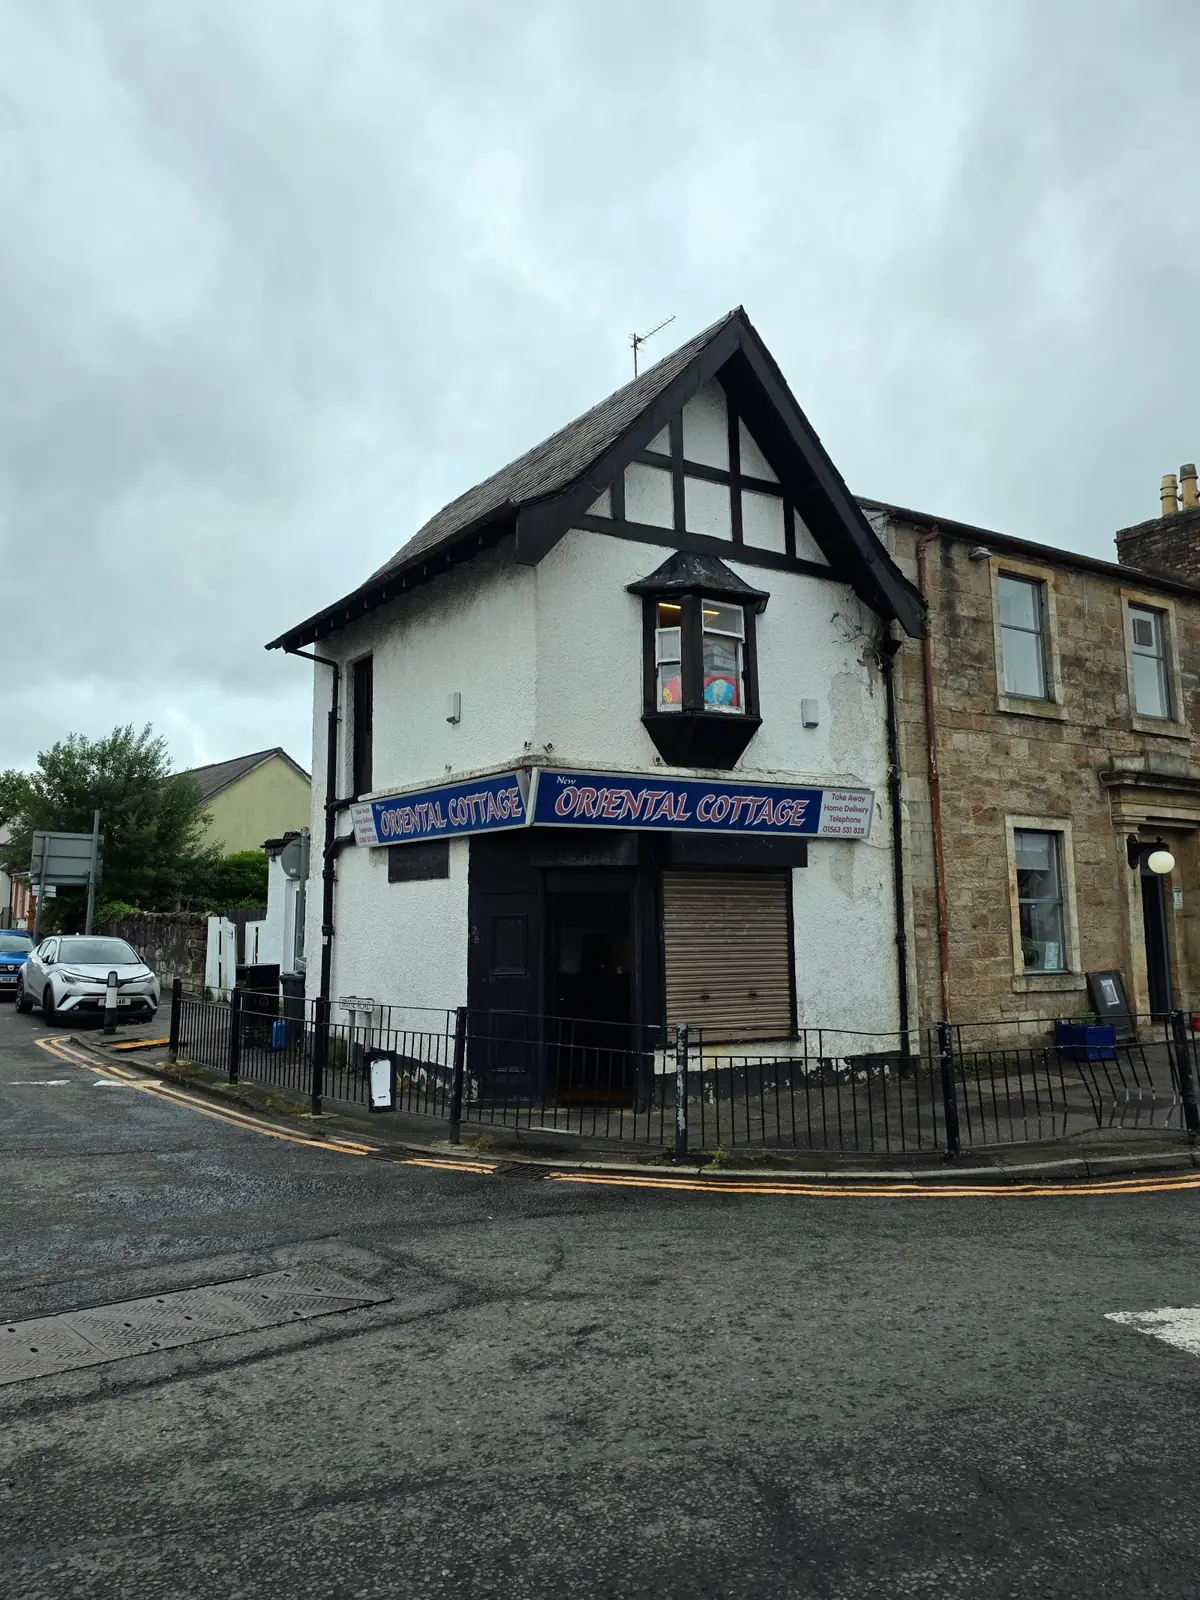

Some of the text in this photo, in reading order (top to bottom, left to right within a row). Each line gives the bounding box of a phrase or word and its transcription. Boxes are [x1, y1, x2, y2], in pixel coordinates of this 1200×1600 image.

[556, 775, 577, 785] New
[832, 793, 866, 804] Take Away
[381, 786, 523, 837] ORIENTAL COTTAGE
[554, 786, 810, 827] ORIENTAL COTTAGE
[824, 804, 869, 815] Home Delivery
[829, 815, 862, 824] Telephone
[822, 825, 841, 833] 01563
[842, 826, 852, 834] 531
